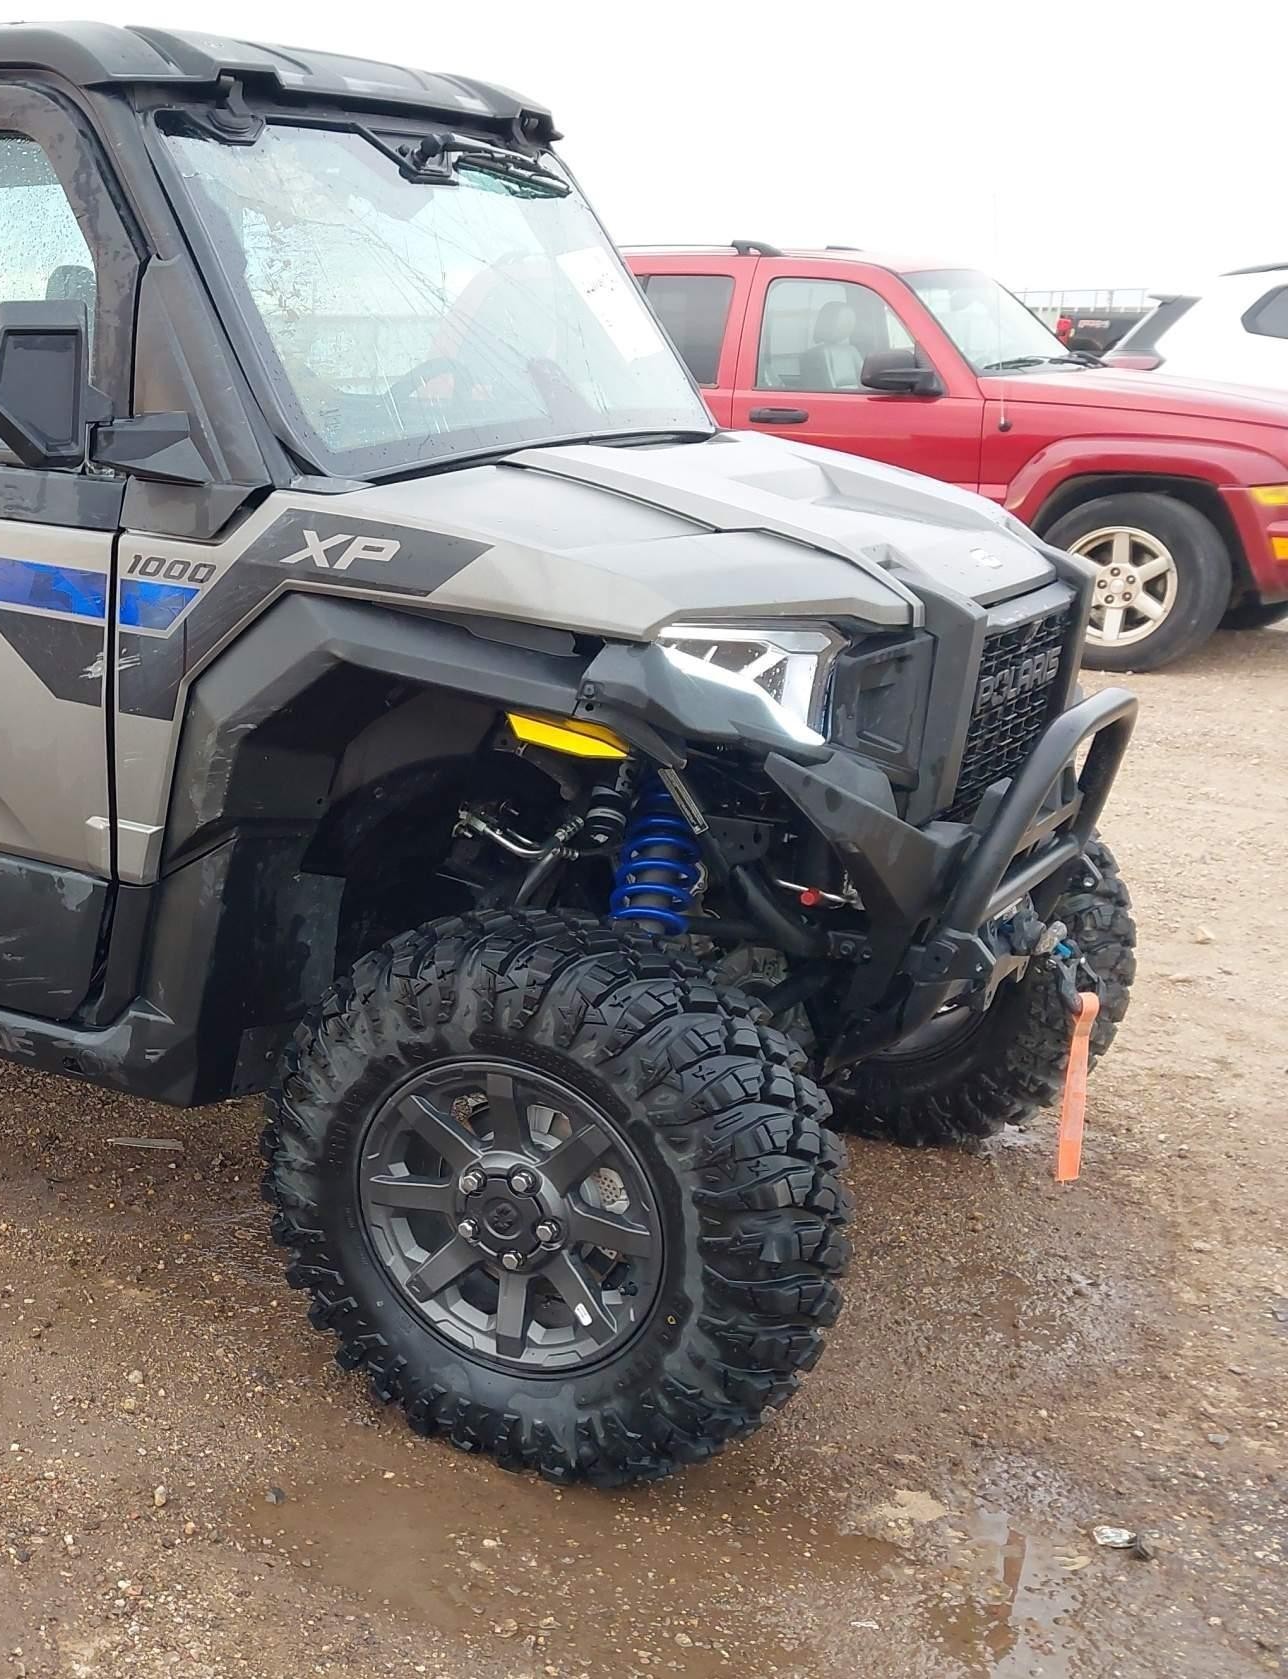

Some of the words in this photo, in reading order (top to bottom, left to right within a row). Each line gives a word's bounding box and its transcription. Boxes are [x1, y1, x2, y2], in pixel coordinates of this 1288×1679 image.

[127, 553, 217, 584] 1000
[279, 528, 402, 571] XP
[976, 645, 1063, 707] POLARIS
